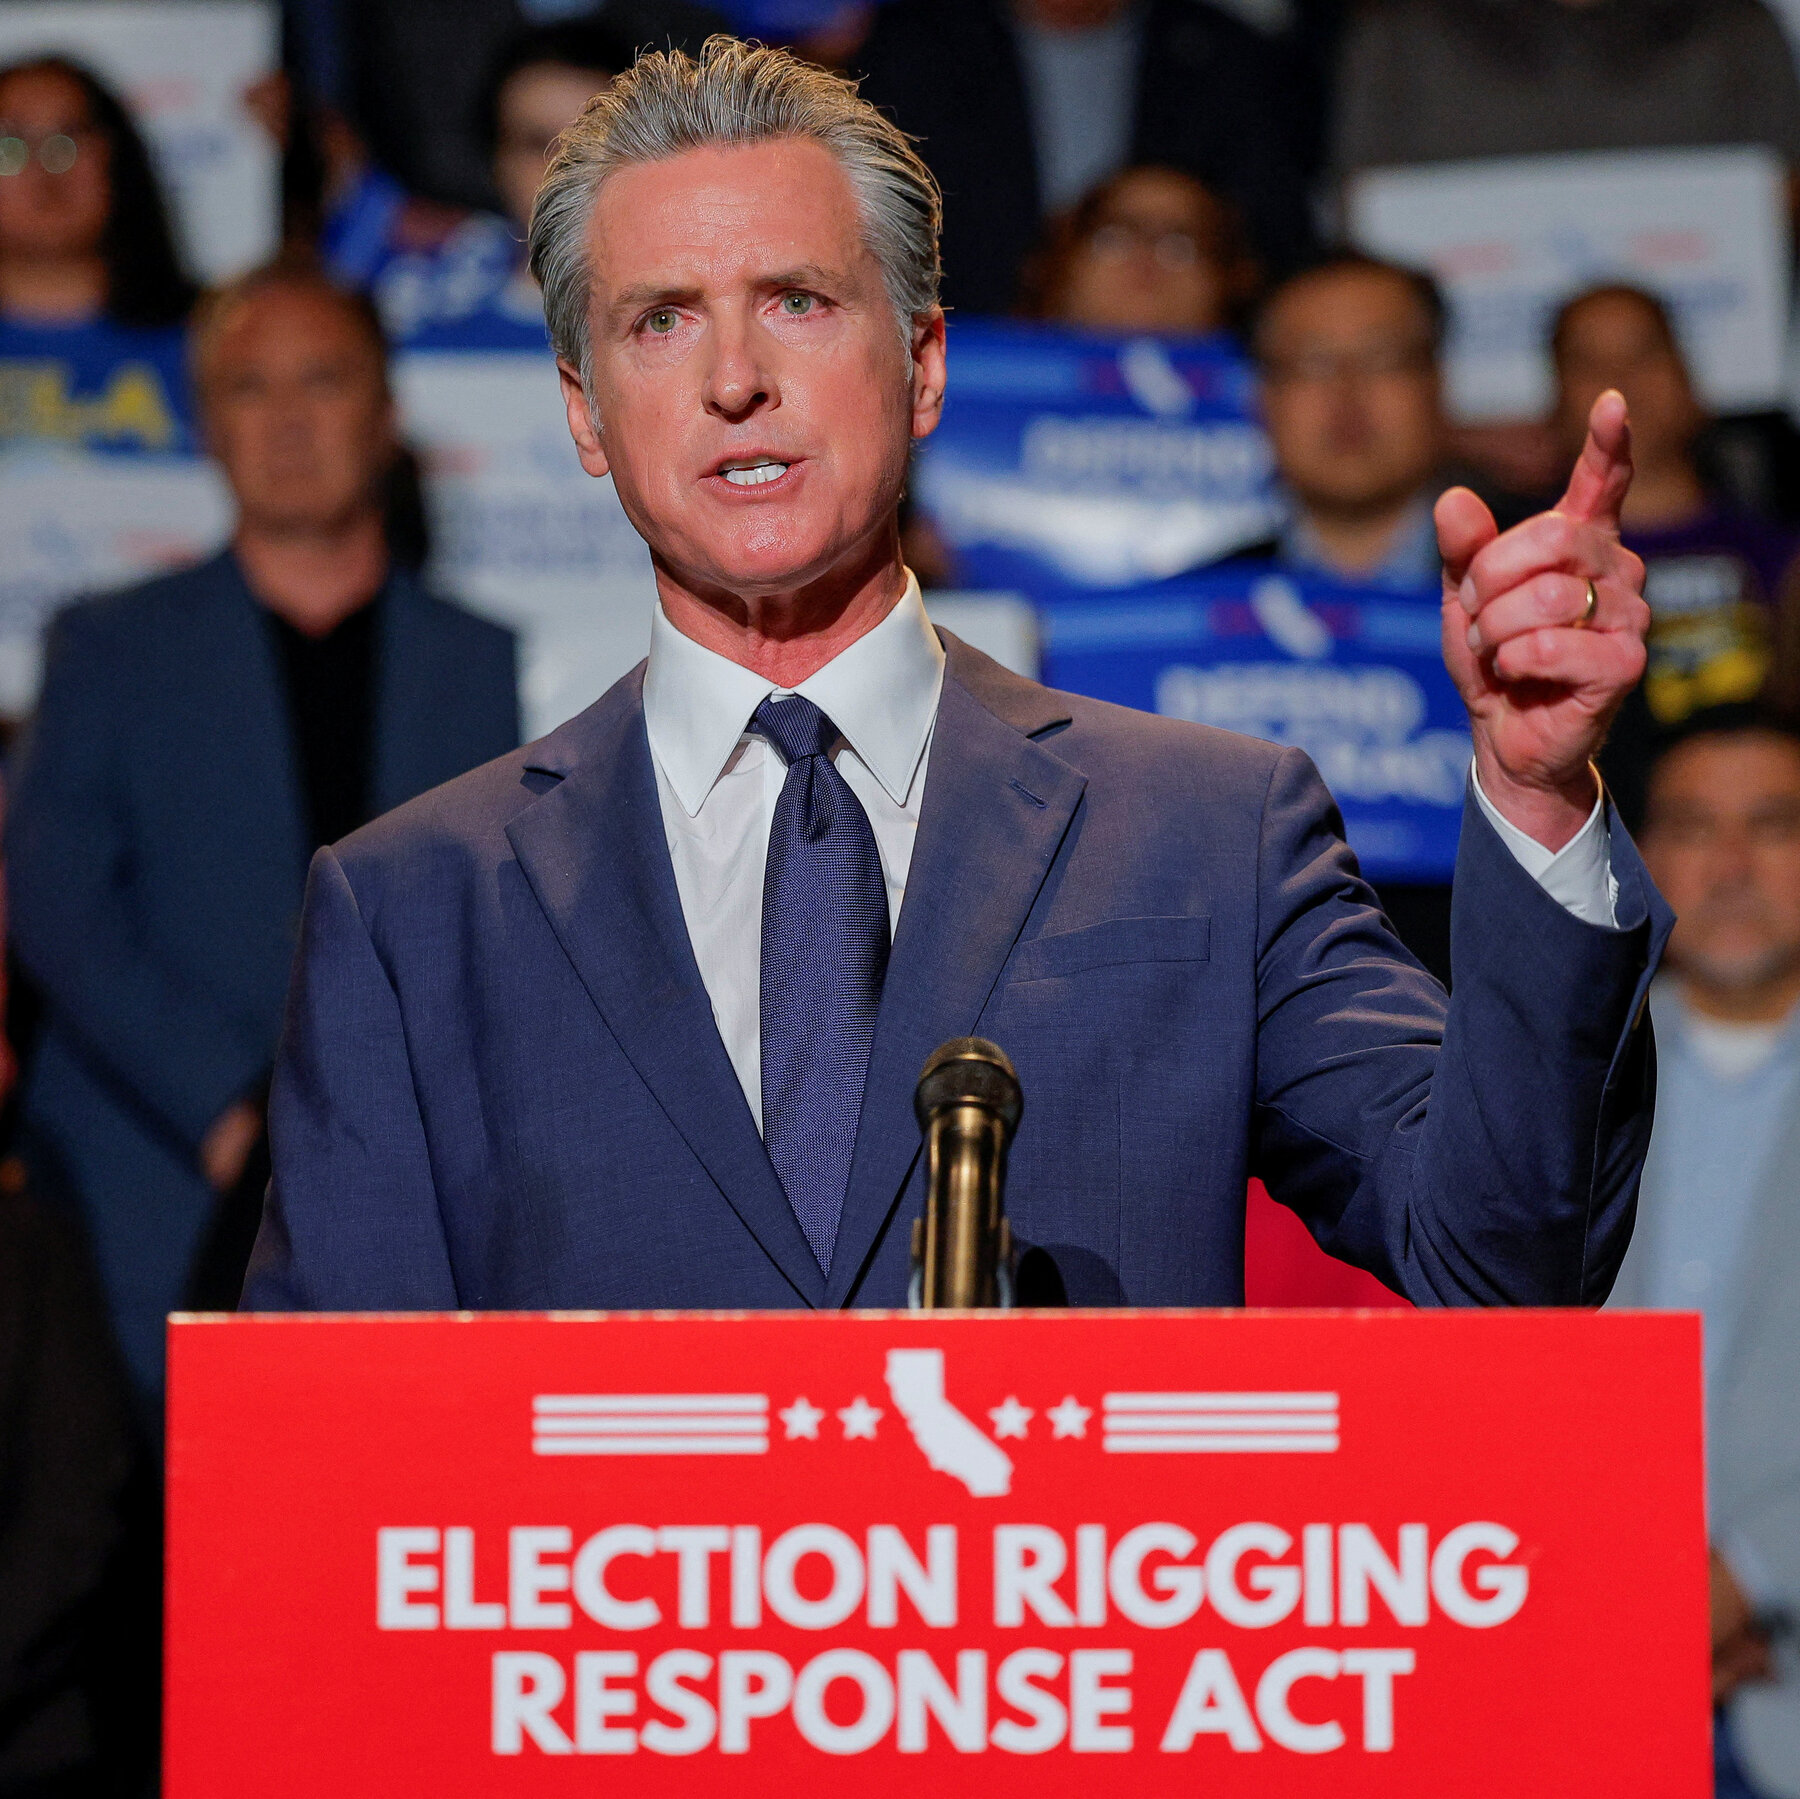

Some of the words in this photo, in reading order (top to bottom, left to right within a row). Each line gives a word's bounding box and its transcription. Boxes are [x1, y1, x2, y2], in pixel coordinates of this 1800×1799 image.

[378, 1524, 957, 1630] ELECTION
[994, 1522, 1529, 1629] RIGGING
[492, 1648, 1133, 1755] RESPONSE
[1162, 1648, 1415, 1754] ACT
